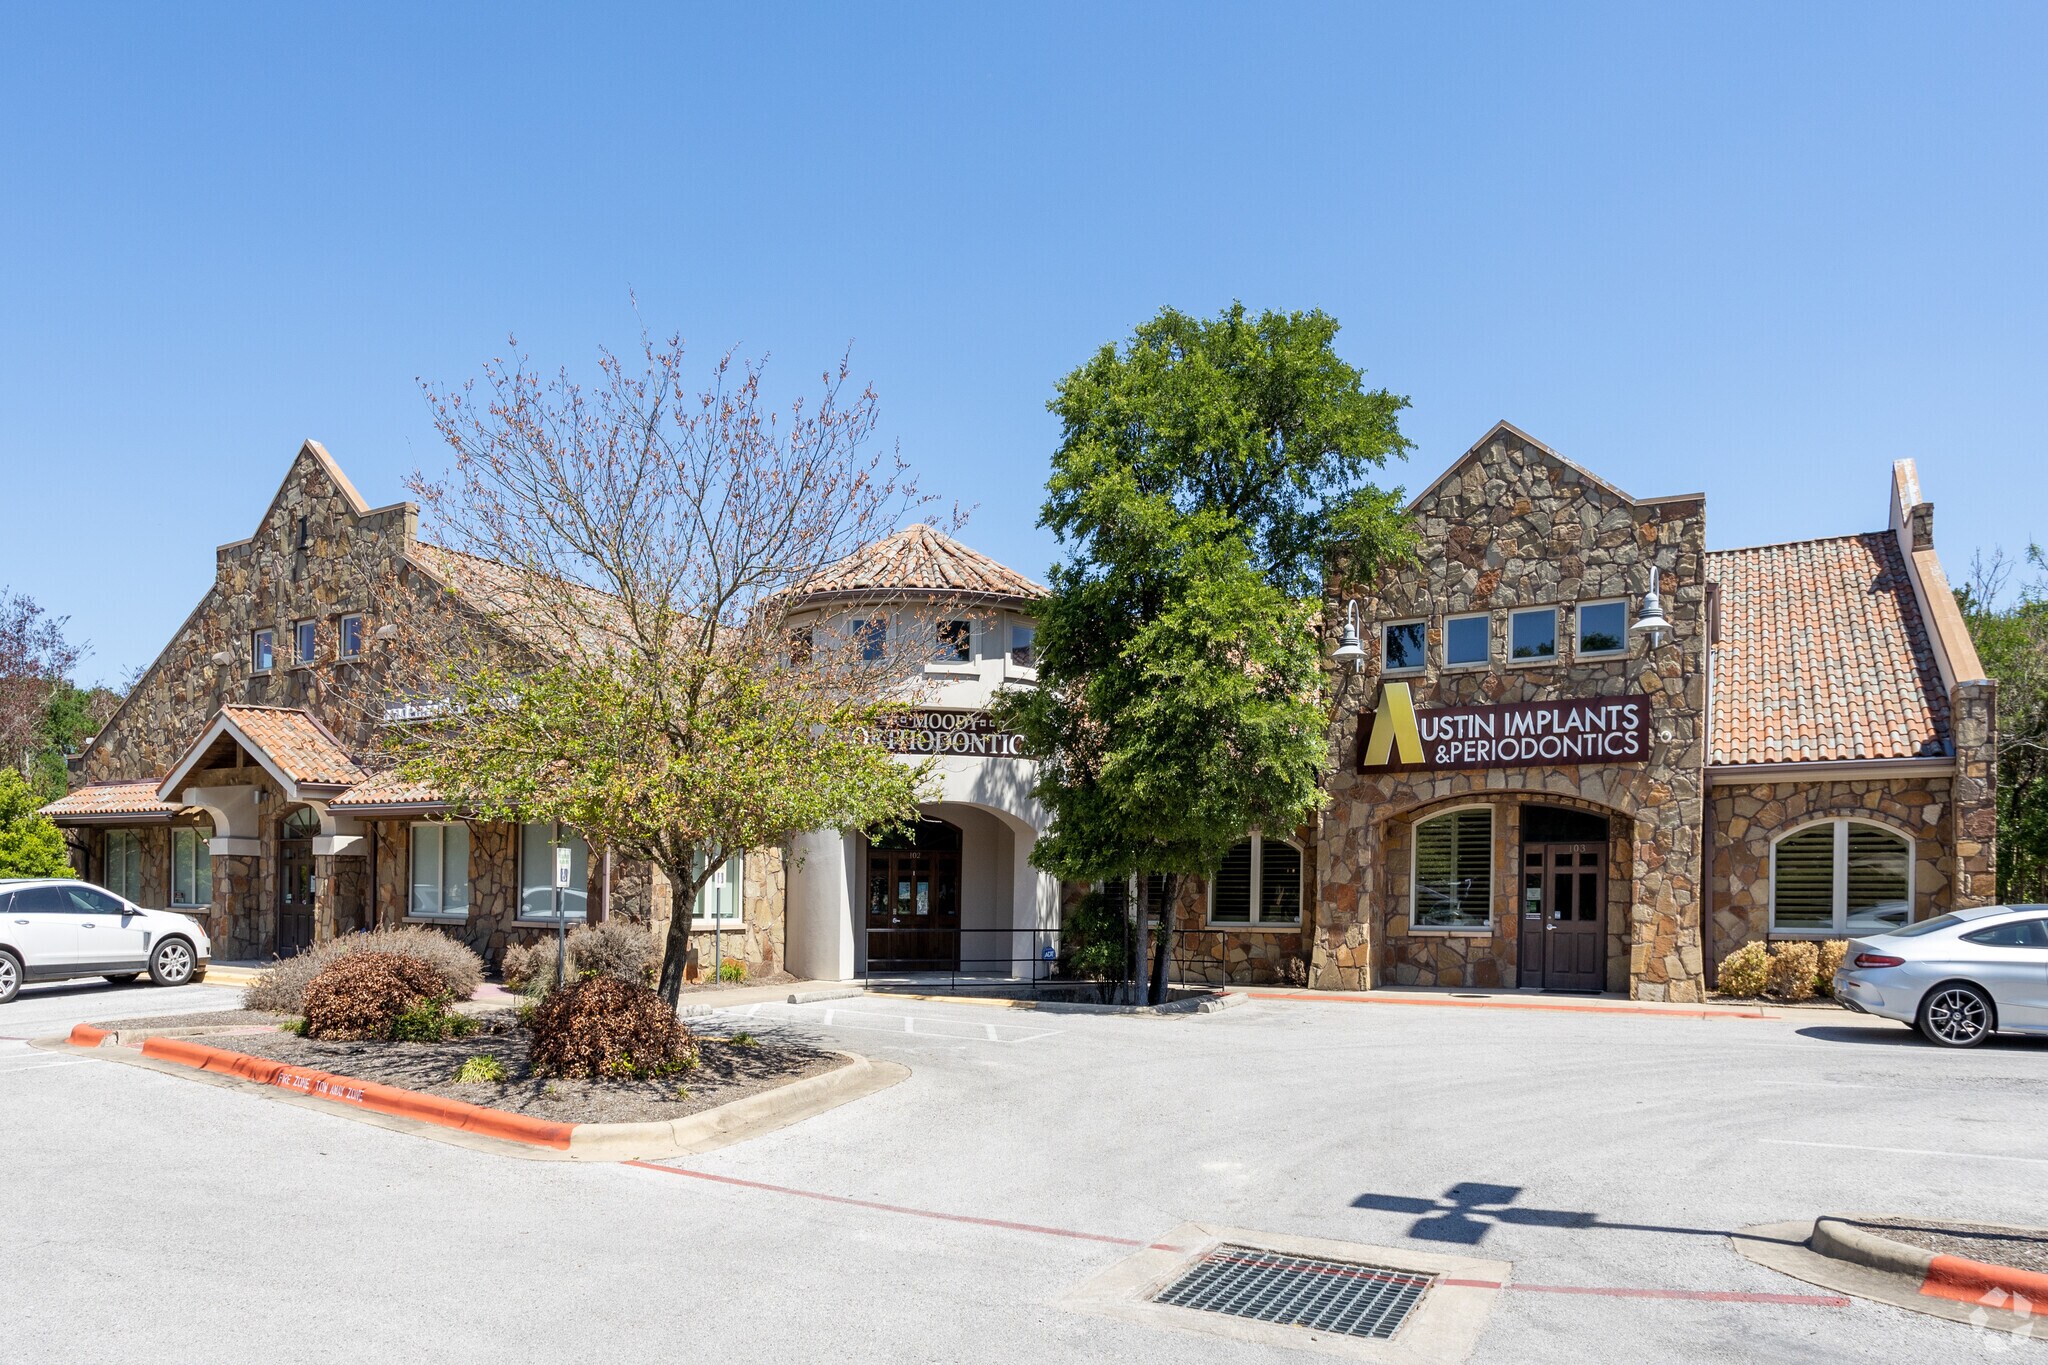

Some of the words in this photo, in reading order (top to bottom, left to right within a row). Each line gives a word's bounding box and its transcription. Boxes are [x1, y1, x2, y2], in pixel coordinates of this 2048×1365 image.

[913, 712, 979, 731] MOODY
[1504, 704, 1639, 737] IMPLANTS
[1569, 844, 1586, 853] 103
[277, 1072, 292, 1085] FIRE
[293, 1075, 311, 1090] ZONE
[315, 1080, 329, 1093] TOW
[330, 1084, 345, 1097] AWAY
[346, 1087, 365, 1103] ZONE
